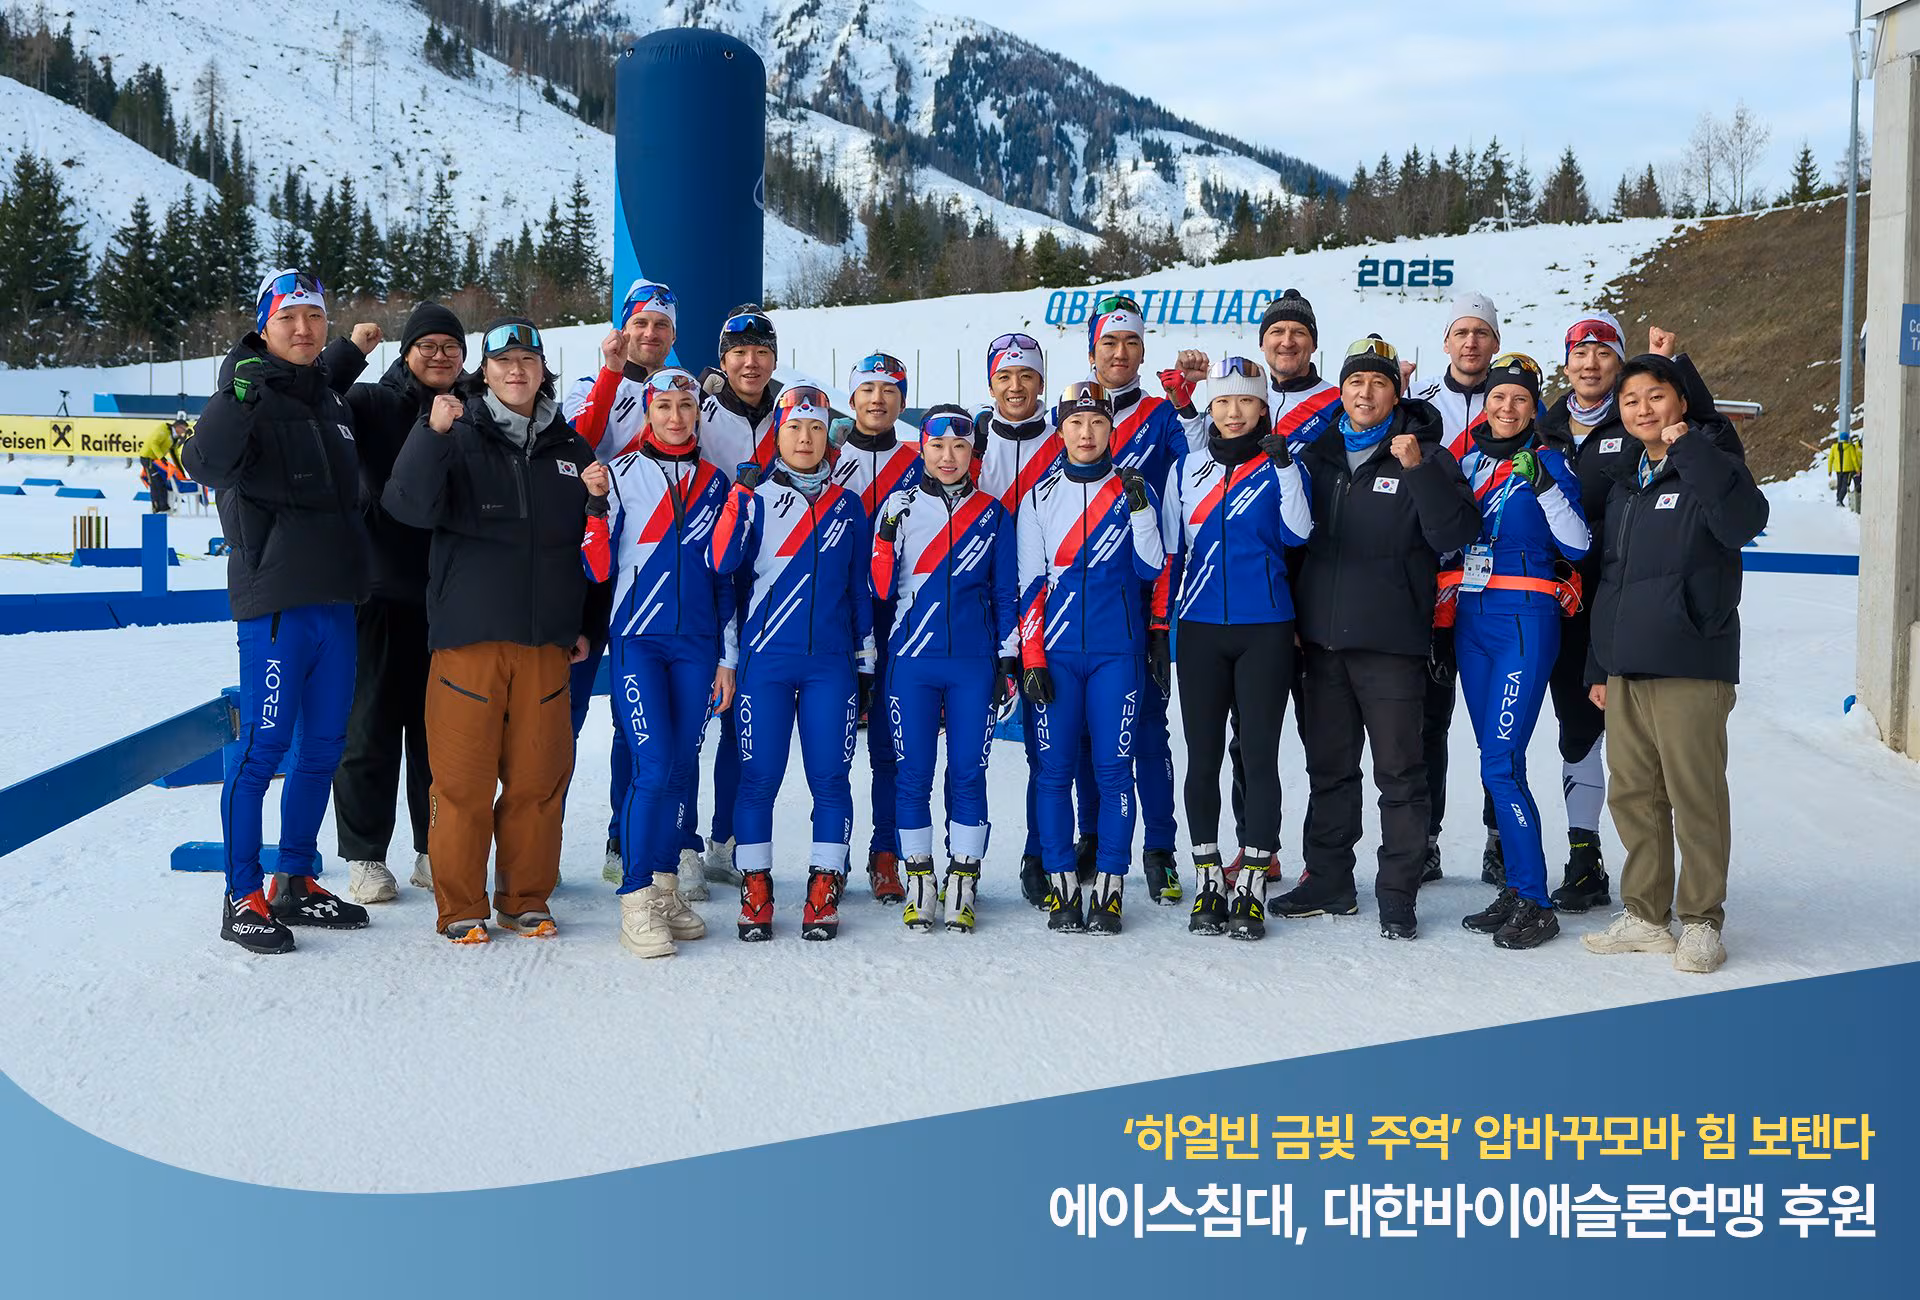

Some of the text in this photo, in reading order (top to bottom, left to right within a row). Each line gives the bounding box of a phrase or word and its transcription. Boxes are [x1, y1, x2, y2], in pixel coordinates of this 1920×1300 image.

[1358, 259, 1454, 287] 2025
[1045, 289, 1284, 325] OBTILLIAC
[260, 659, 281, 729] KOREA
[623, 674, 650, 746] KOREA
[740, 694, 753, 761] KOREA
[843, 693, 857, 762] KOREA
[1035, 702, 1050, 751] OREA
[1117, 690, 1137, 757] KOREA
[1497, 670, 1522, 740] KOREA
[889, 695, 905, 762] KOREA
[232, 922, 276, 936] alpina
